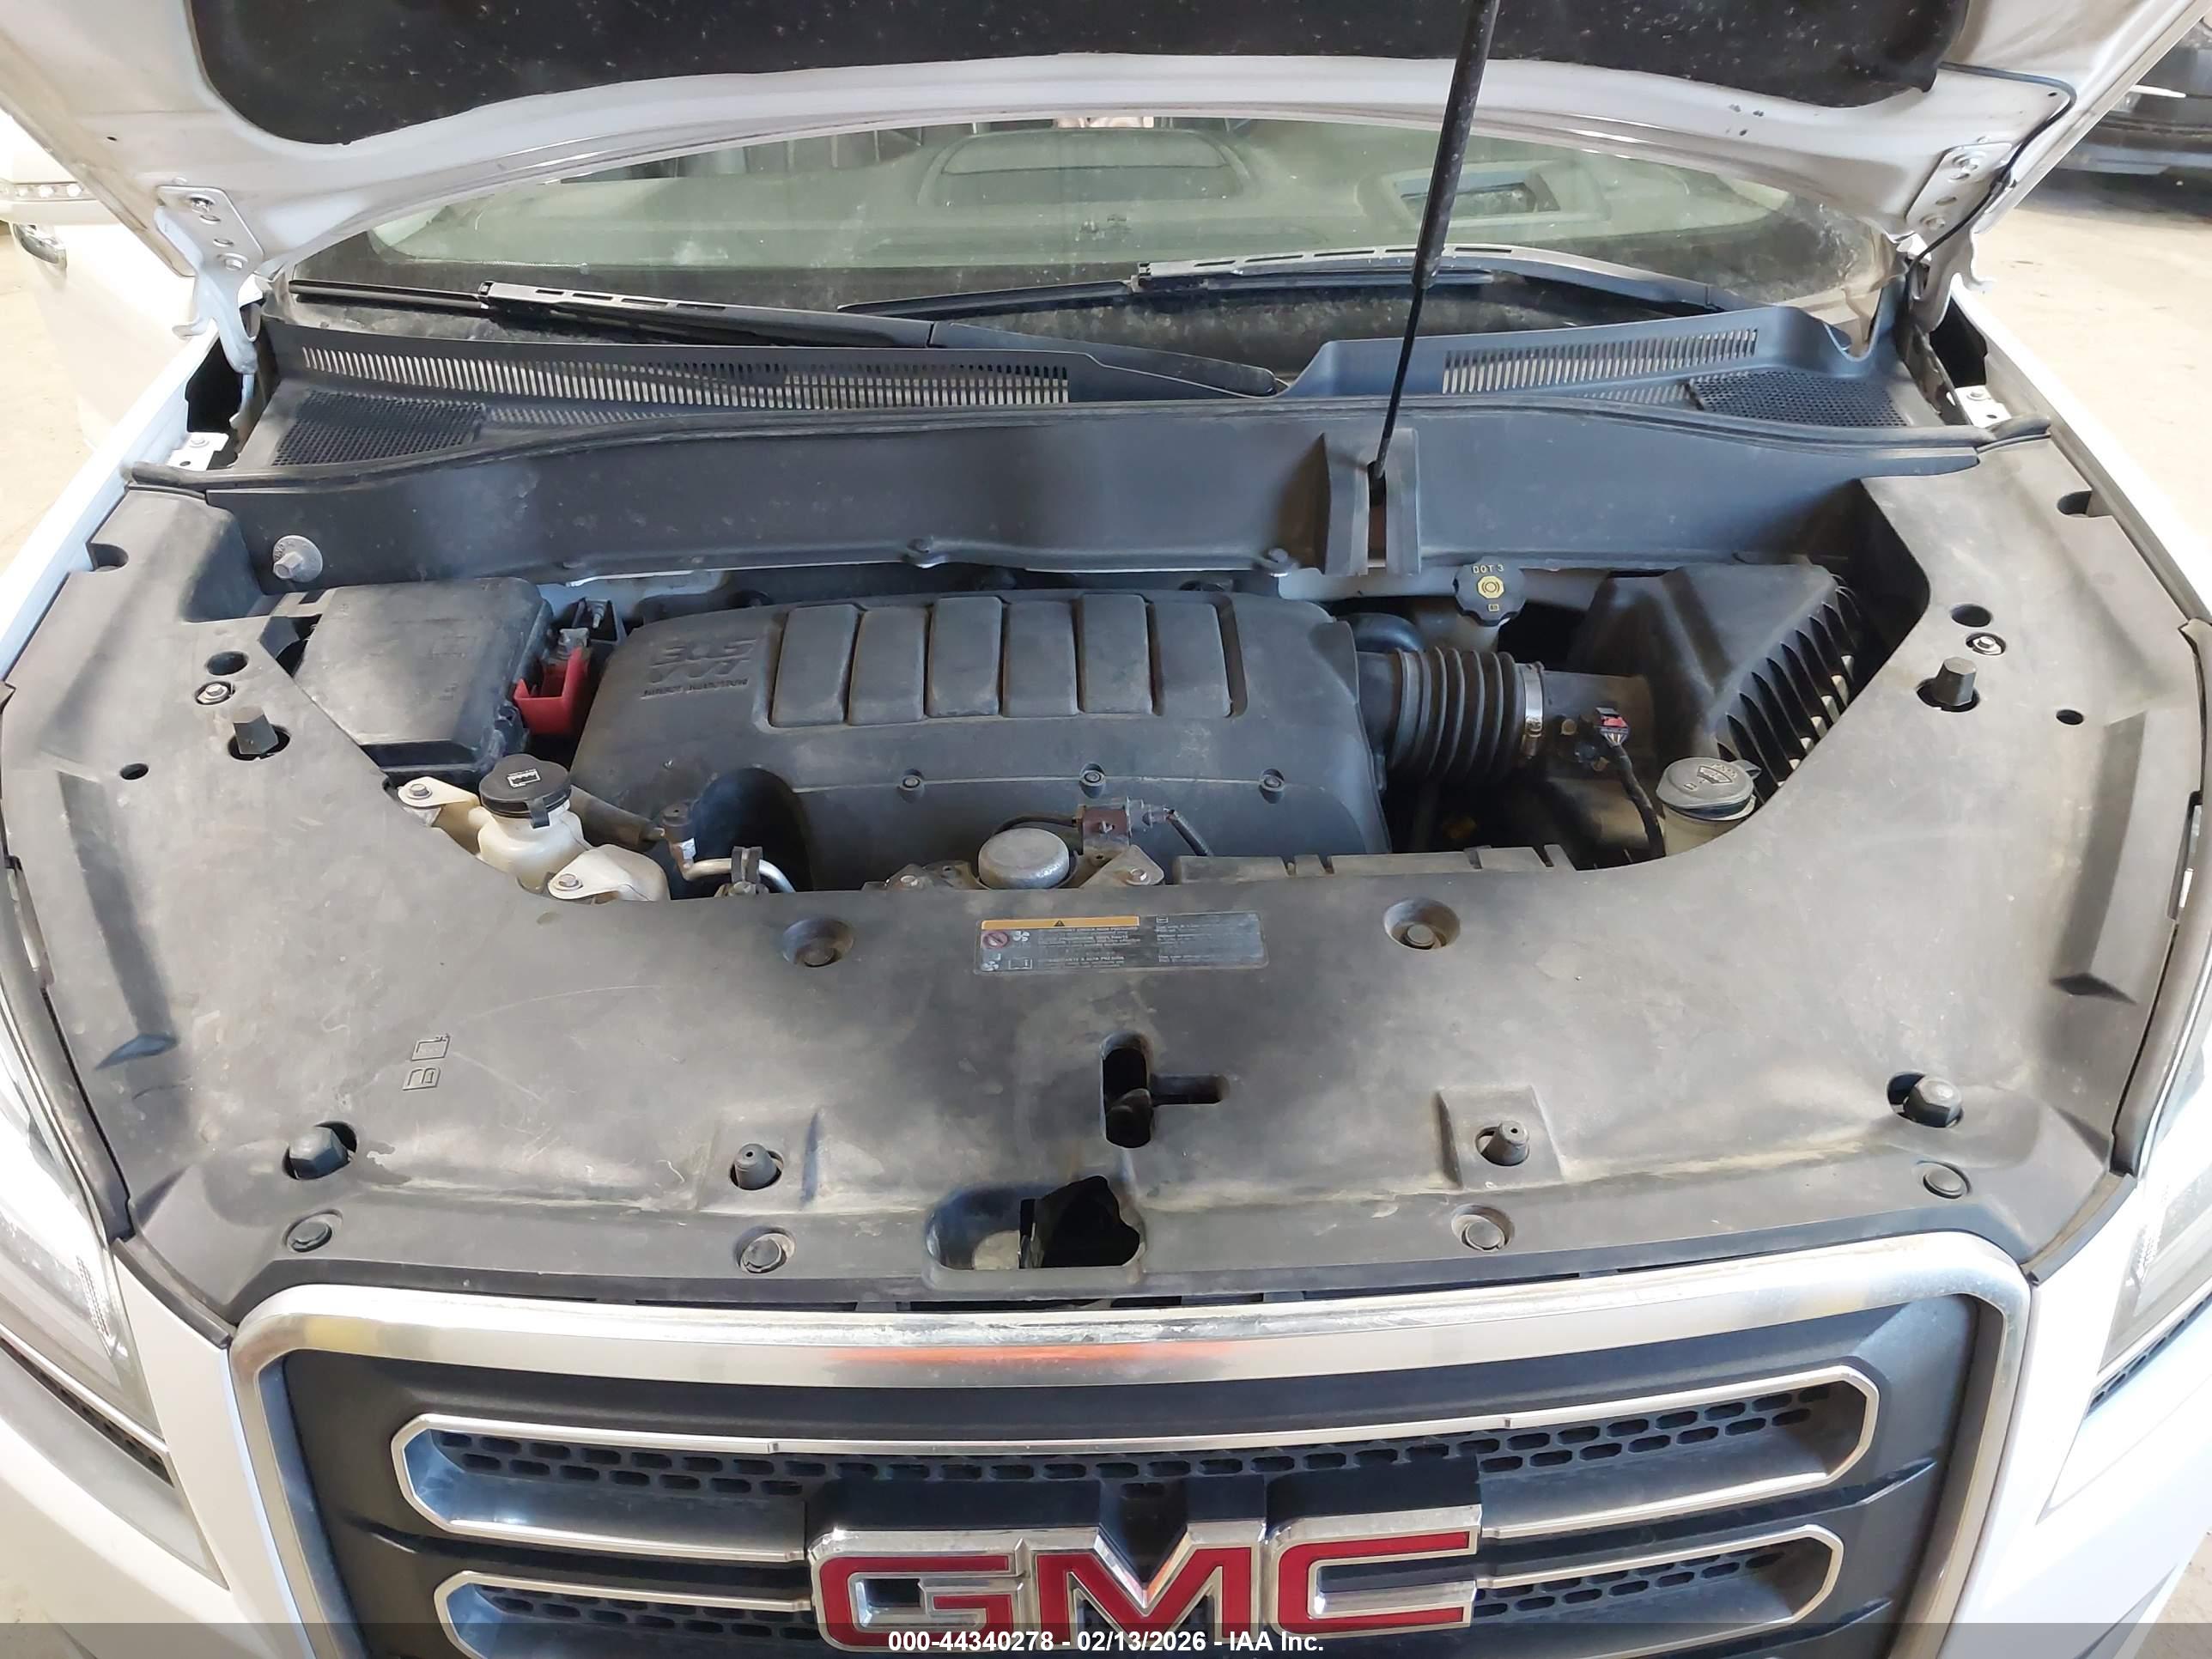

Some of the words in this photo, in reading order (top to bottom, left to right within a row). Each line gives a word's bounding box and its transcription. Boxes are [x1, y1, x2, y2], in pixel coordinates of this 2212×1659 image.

[1472, 564, 1494, 574] DOT
[1497, 563, 1504, 573] 3
[808, 1504, 1483, 1653] GMC
